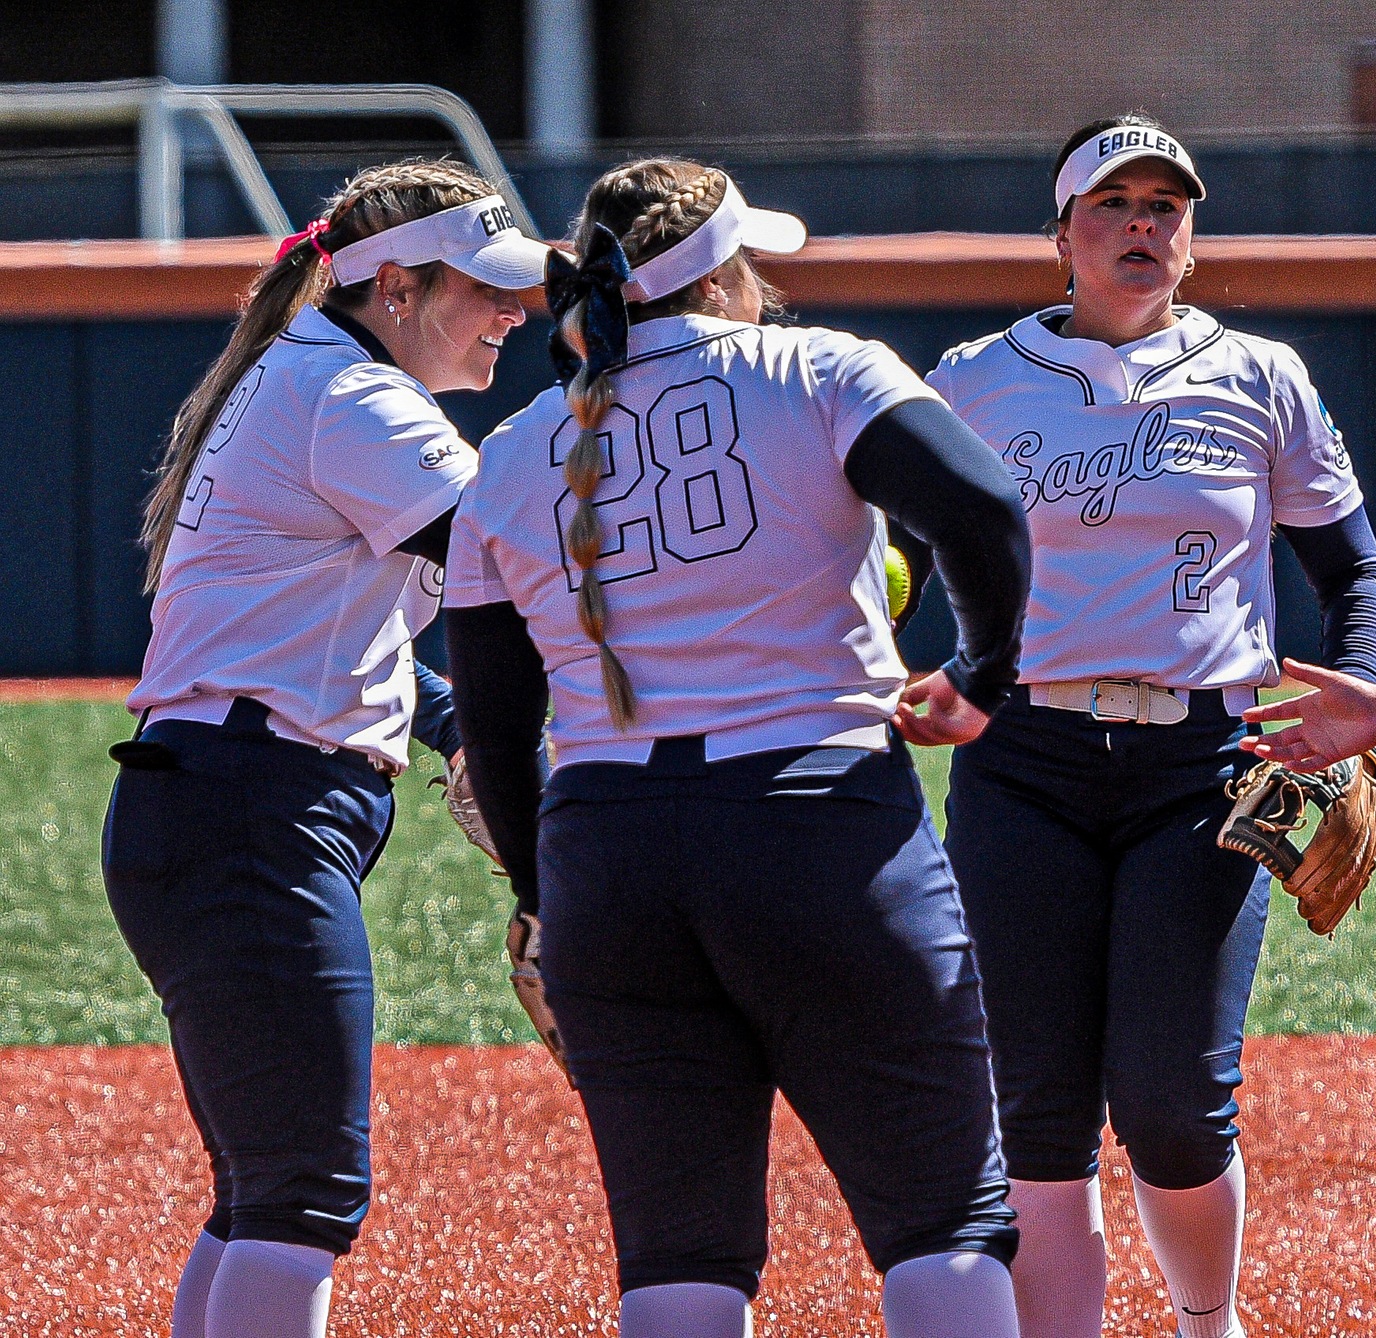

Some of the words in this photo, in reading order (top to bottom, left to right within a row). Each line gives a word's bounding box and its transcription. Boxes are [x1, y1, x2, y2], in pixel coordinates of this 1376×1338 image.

[1099, 131, 1178, 159] EAGLES
[479, 206, 515, 237] EAG
[423, 445, 460, 466] SAC
[549, 375, 758, 593] 28
[1002, 401, 1238, 527] Eagles
[1172, 531, 1218, 614] 2
